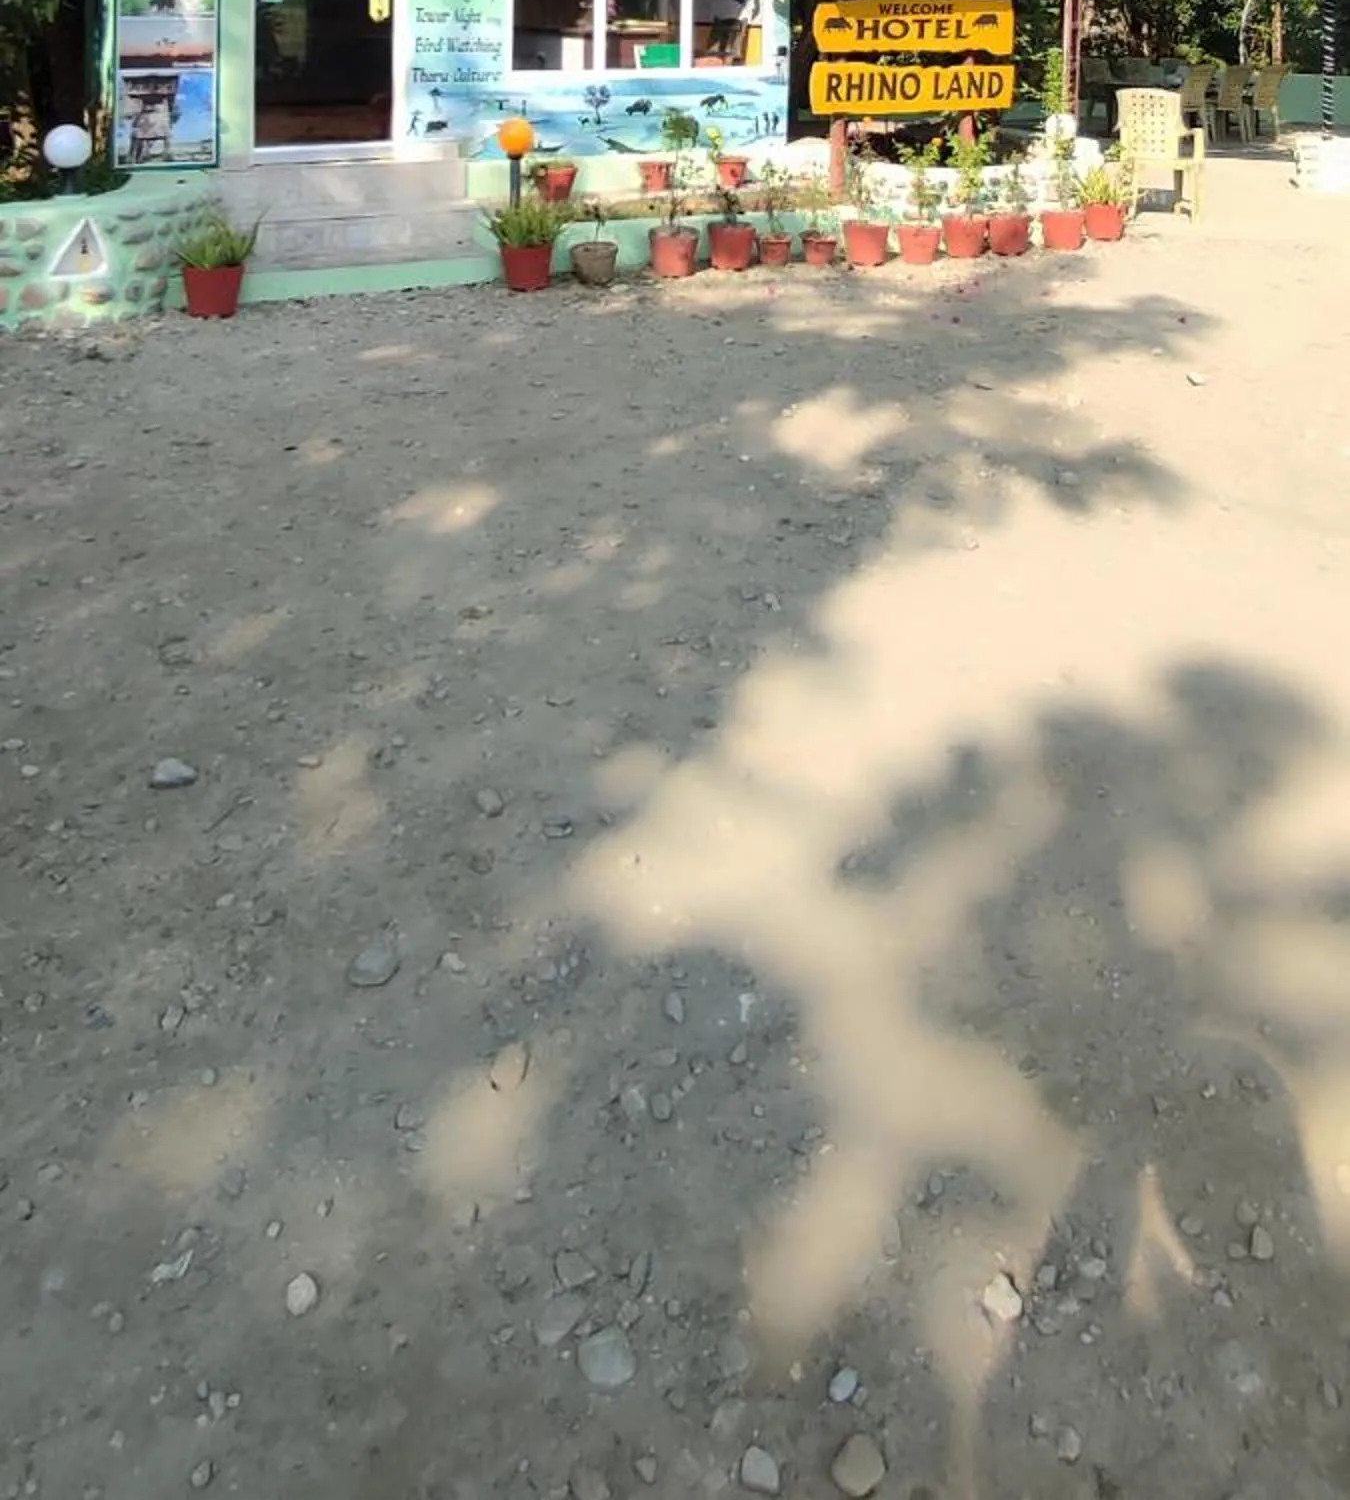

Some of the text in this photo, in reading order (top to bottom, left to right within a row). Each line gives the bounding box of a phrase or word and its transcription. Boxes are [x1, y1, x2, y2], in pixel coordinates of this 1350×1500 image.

[415, 7, 451, 23] Tower
[453, 7, 482, 31] Night
[878, 2, 956, 16] WELCOME
[855, 17, 971, 41] HOTEL
[415, 36, 503, 61] Bird Watching
[411, 66, 503, 83] Tharu Culture
[824, 70, 1005, 103] RHINO LAND
